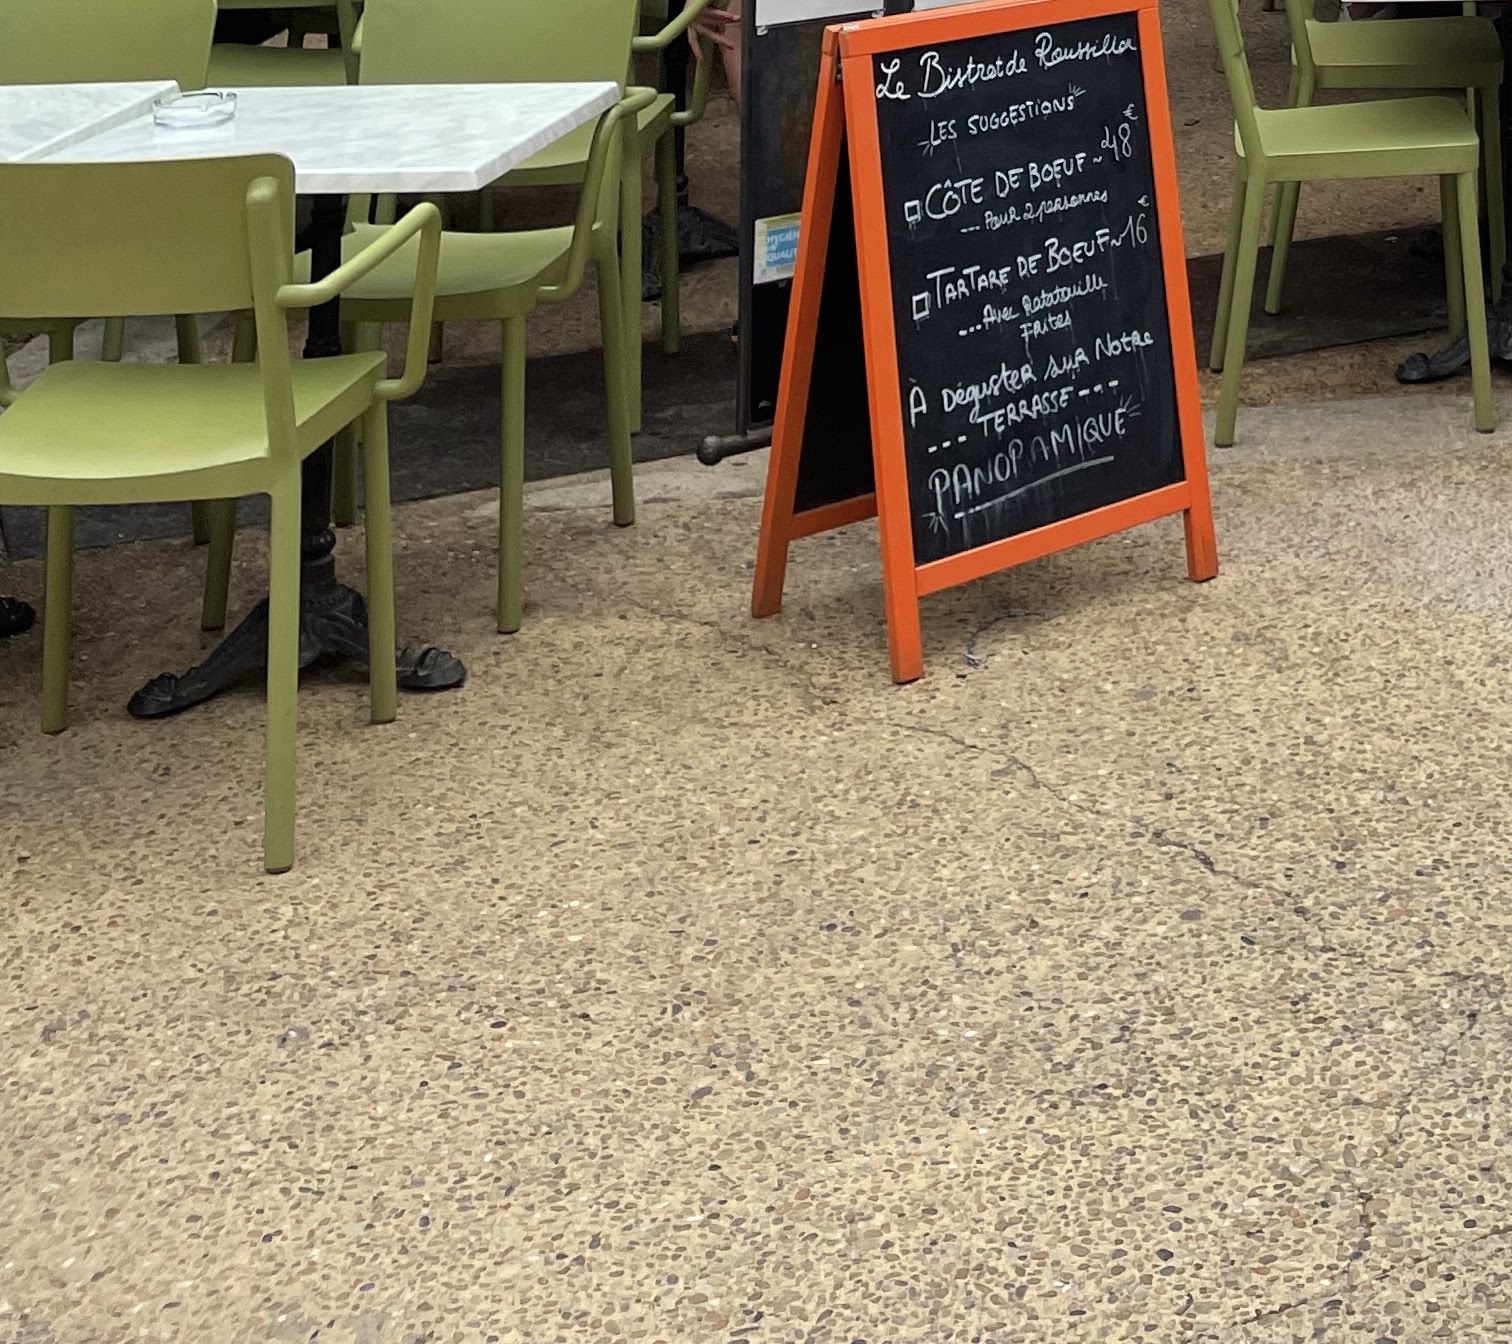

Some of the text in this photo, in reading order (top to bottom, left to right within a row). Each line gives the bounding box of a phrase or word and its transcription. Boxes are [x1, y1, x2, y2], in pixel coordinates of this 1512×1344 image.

[875, 58, 911, 99] Le
[929, 95, 1076, 146] LES SUGGESTIONS
